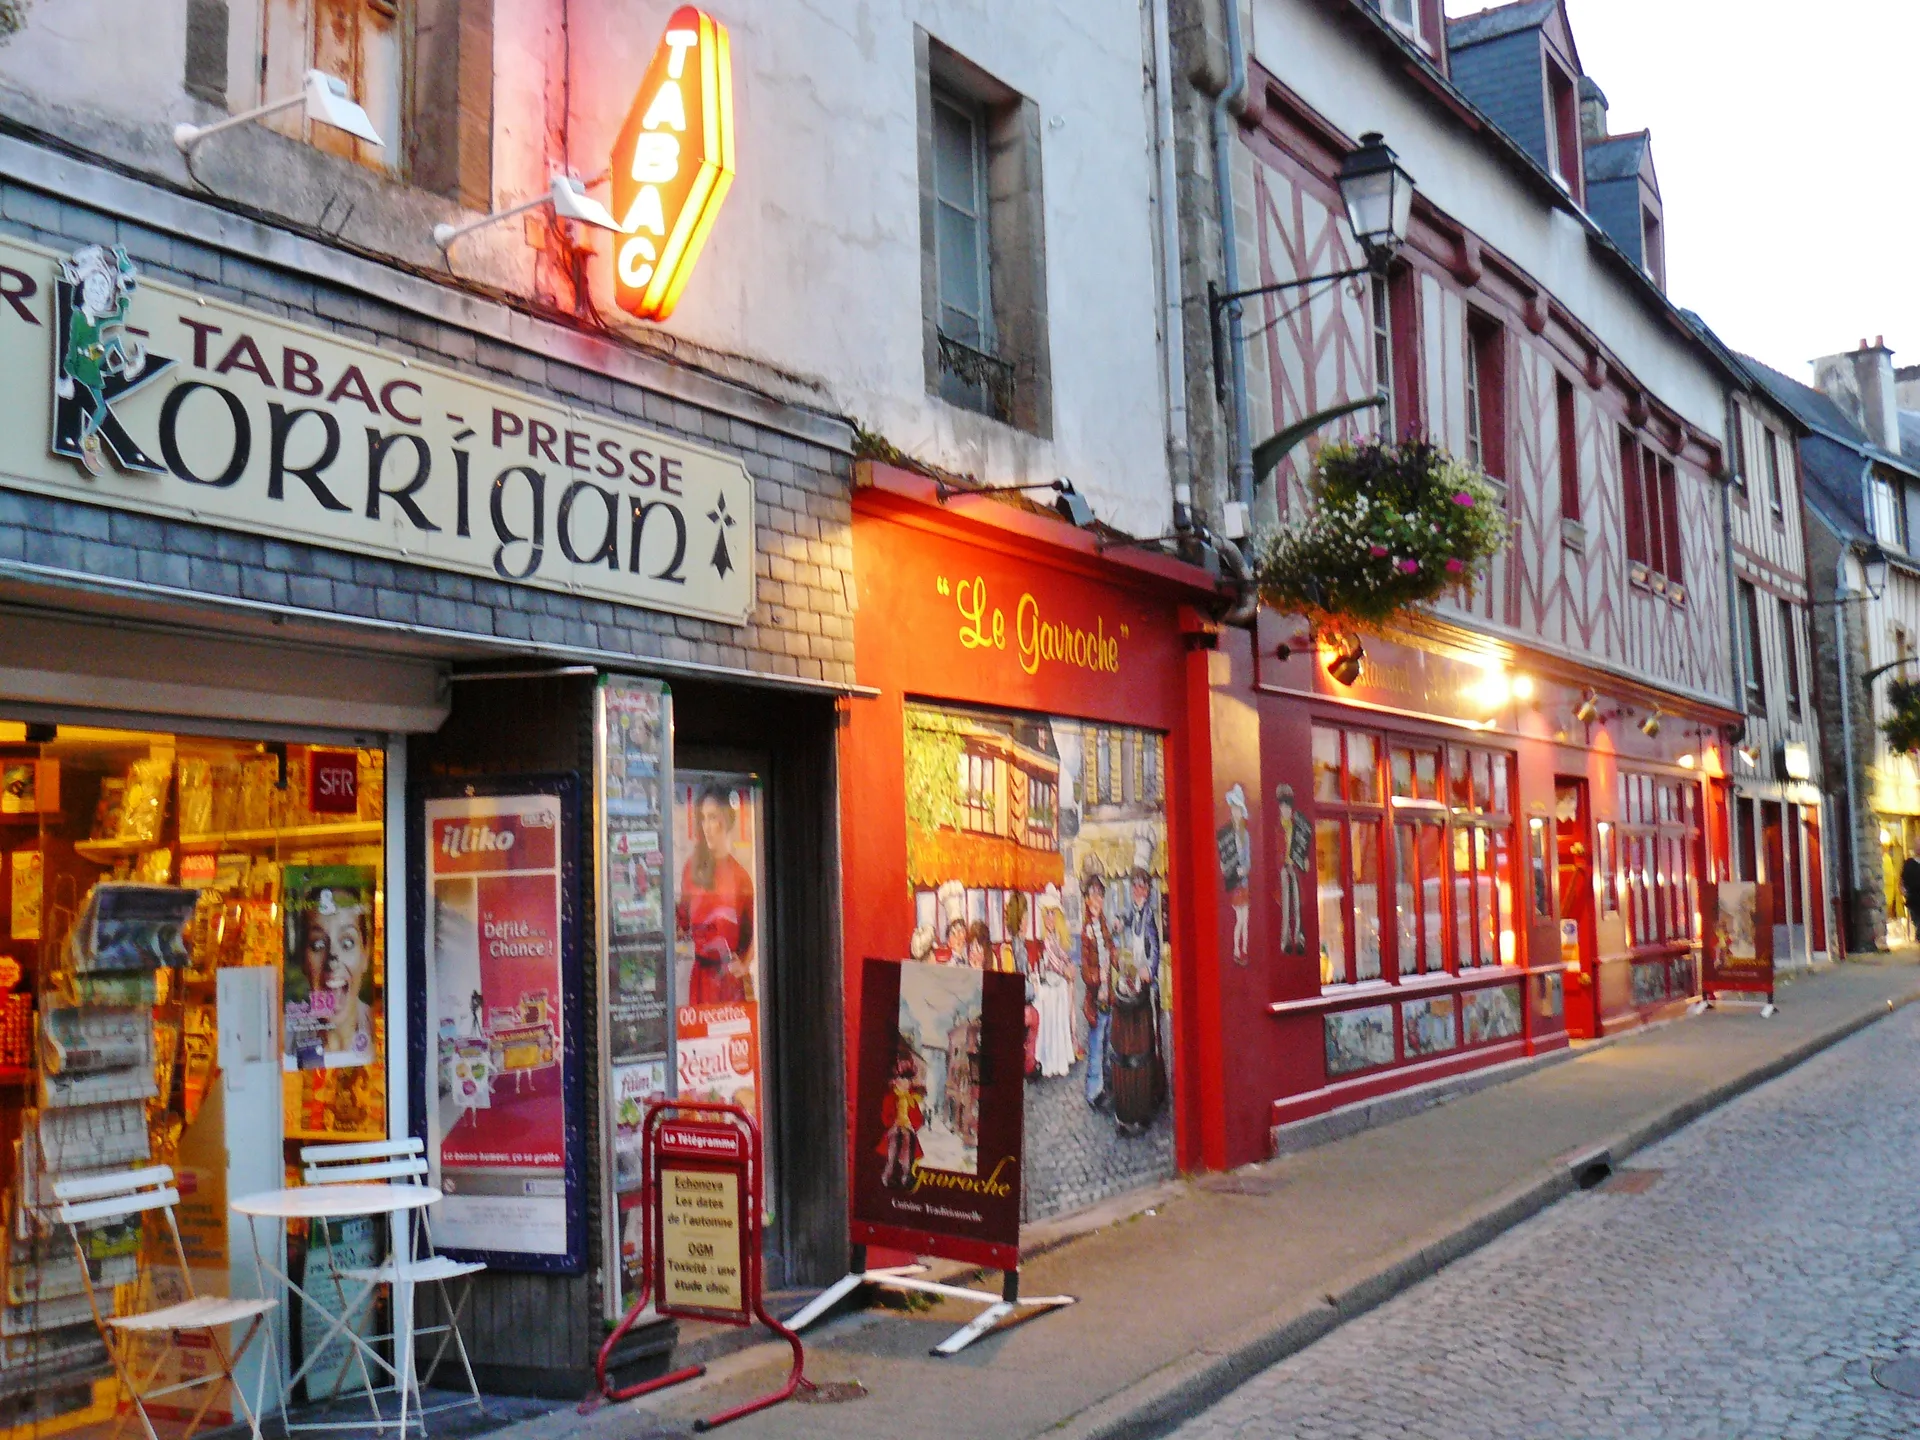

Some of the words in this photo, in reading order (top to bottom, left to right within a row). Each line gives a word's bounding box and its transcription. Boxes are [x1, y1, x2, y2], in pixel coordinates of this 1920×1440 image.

[616, 28, 698, 290] TABAC
[179, 316, 424, 427] TABAC
[491, 408, 684, 498] PRESSE
[319, 767, 354, 797] SFR
[699, 1004, 747, 1024] recettes
[678, 1042, 728, 1085] Régal
[664, 1131, 677, 1144] Le
[677, 1132, 737, 1150] Télégramme
[675, 1194, 693, 1207] Les
[696, 1195, 724, 1209] dates
[667, 1212, 680, 1225] de
[688, 1241, 715, 1257] OGM
[717, 1264, 737, 1277] une
